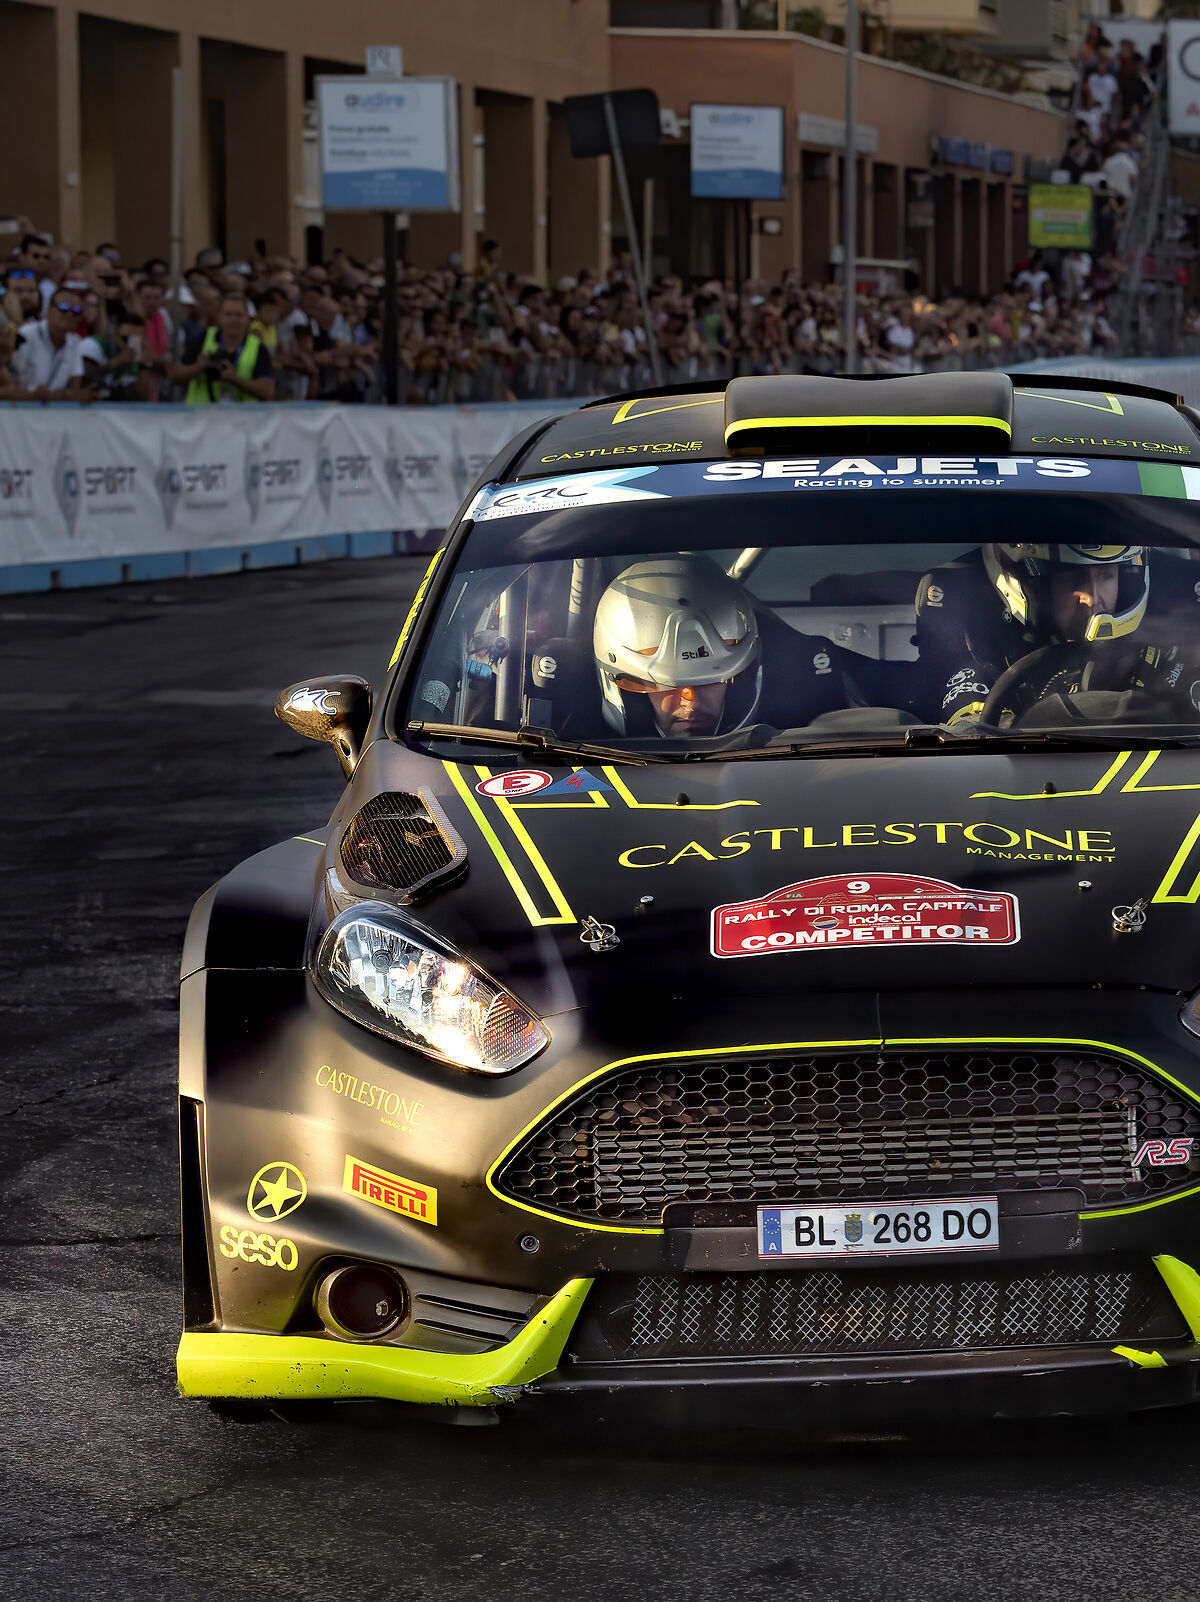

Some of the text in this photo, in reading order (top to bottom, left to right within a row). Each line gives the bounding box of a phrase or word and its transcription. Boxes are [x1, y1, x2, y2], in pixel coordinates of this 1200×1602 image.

[541, 441, 703, 463] CASTLESTONE
[1031, 436, 1191, 453] CASTLESTONE
[703, 457, 1092, 481] SEAJETS
[794, 477, 1005, 488] Racing to summer
[503, 775, 531, 790] E
[618, 822, 1116, 868] CASTLESTONE
[966, 847, 1116, 863] MANAGEMENT
[847, 881, 870, 894] 9
[725, 902, 1003, 924] RALLY DI ROMA CAPITALE
[849, 912, 921, 924] indecal
[741, 925, 989, 949] COMPETITOR
[315, 1065, 424, 1125] CASTLESTONE
[1131, 1138, 1194, 1166] RS
[352, 1164, 428, 1217] PIRELLI
[794, 1208, 991, 1247] BL 268 DO
[219, 1226, 299, 1271] seso
[768, 1242, 778, 1252] A
